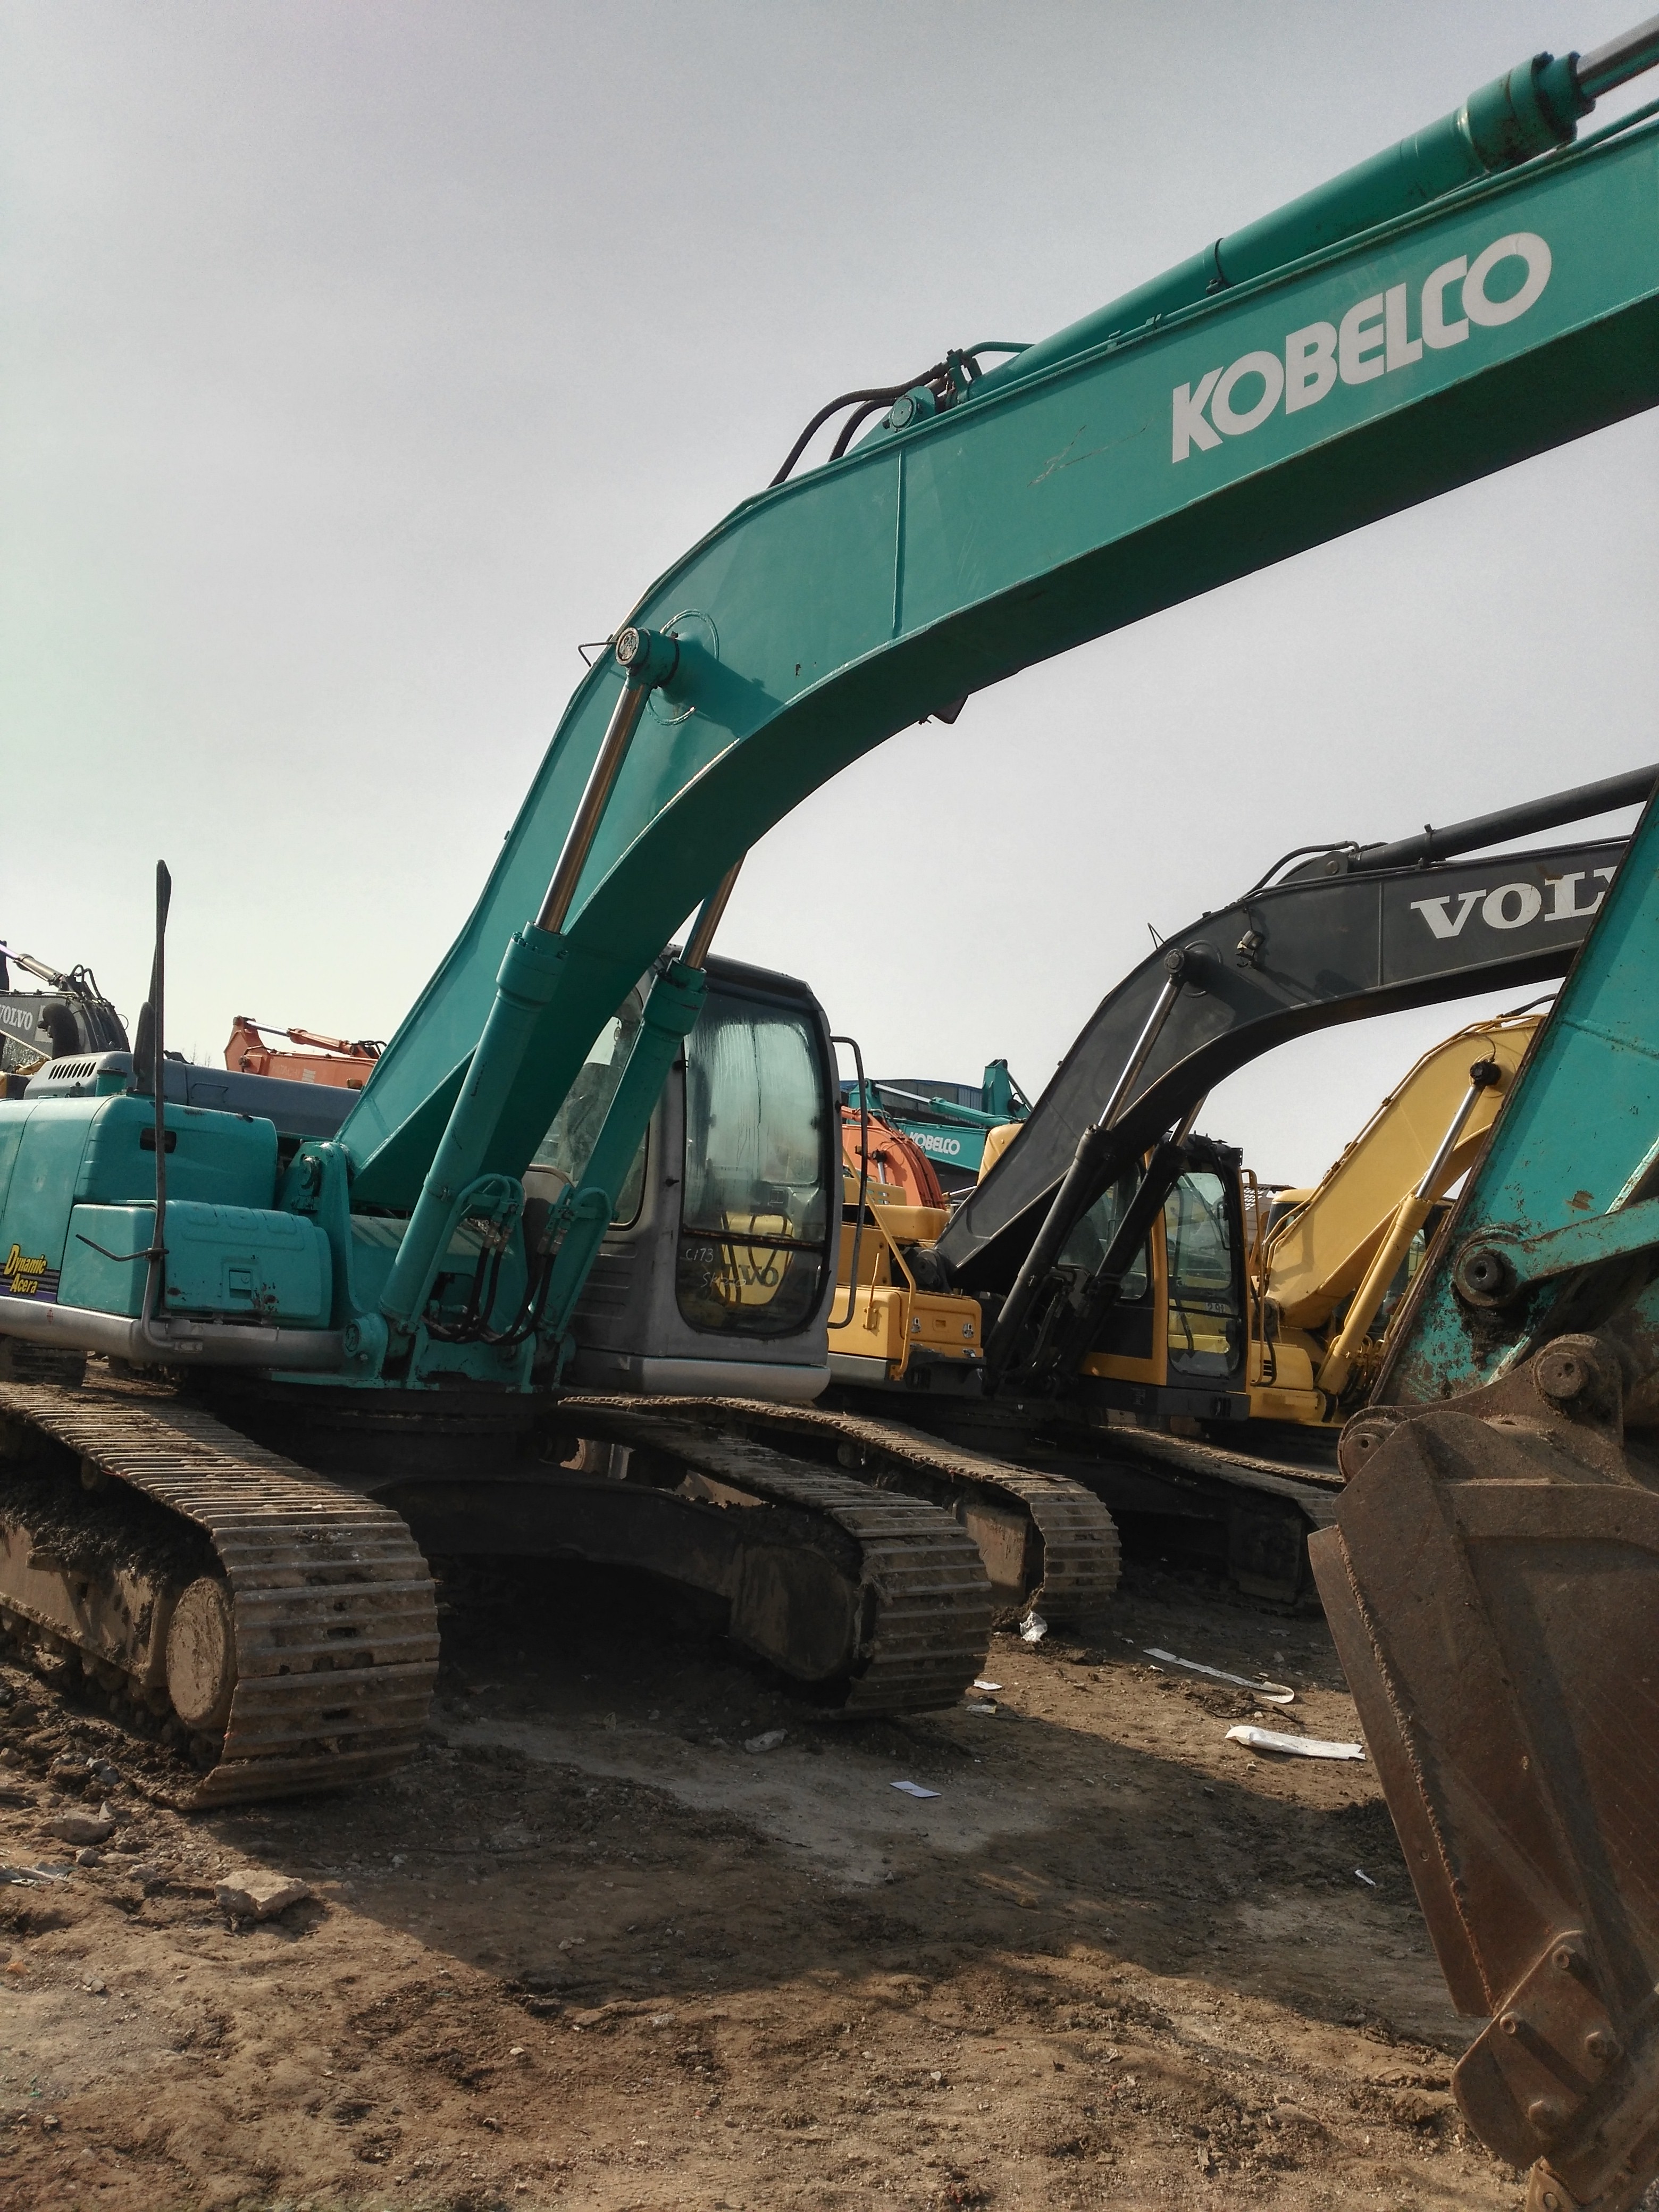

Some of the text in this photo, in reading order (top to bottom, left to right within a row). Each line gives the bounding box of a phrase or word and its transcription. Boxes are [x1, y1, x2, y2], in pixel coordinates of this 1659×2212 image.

[1172, 232, 1552, 464] KOBELCO
[1410, 866, 1617, 939] VOL
[3, 1244, 47, 1275] Dynamic
[686, 1247, 714, 1263] C173
[10, 1273, 39, 1294] Acera
